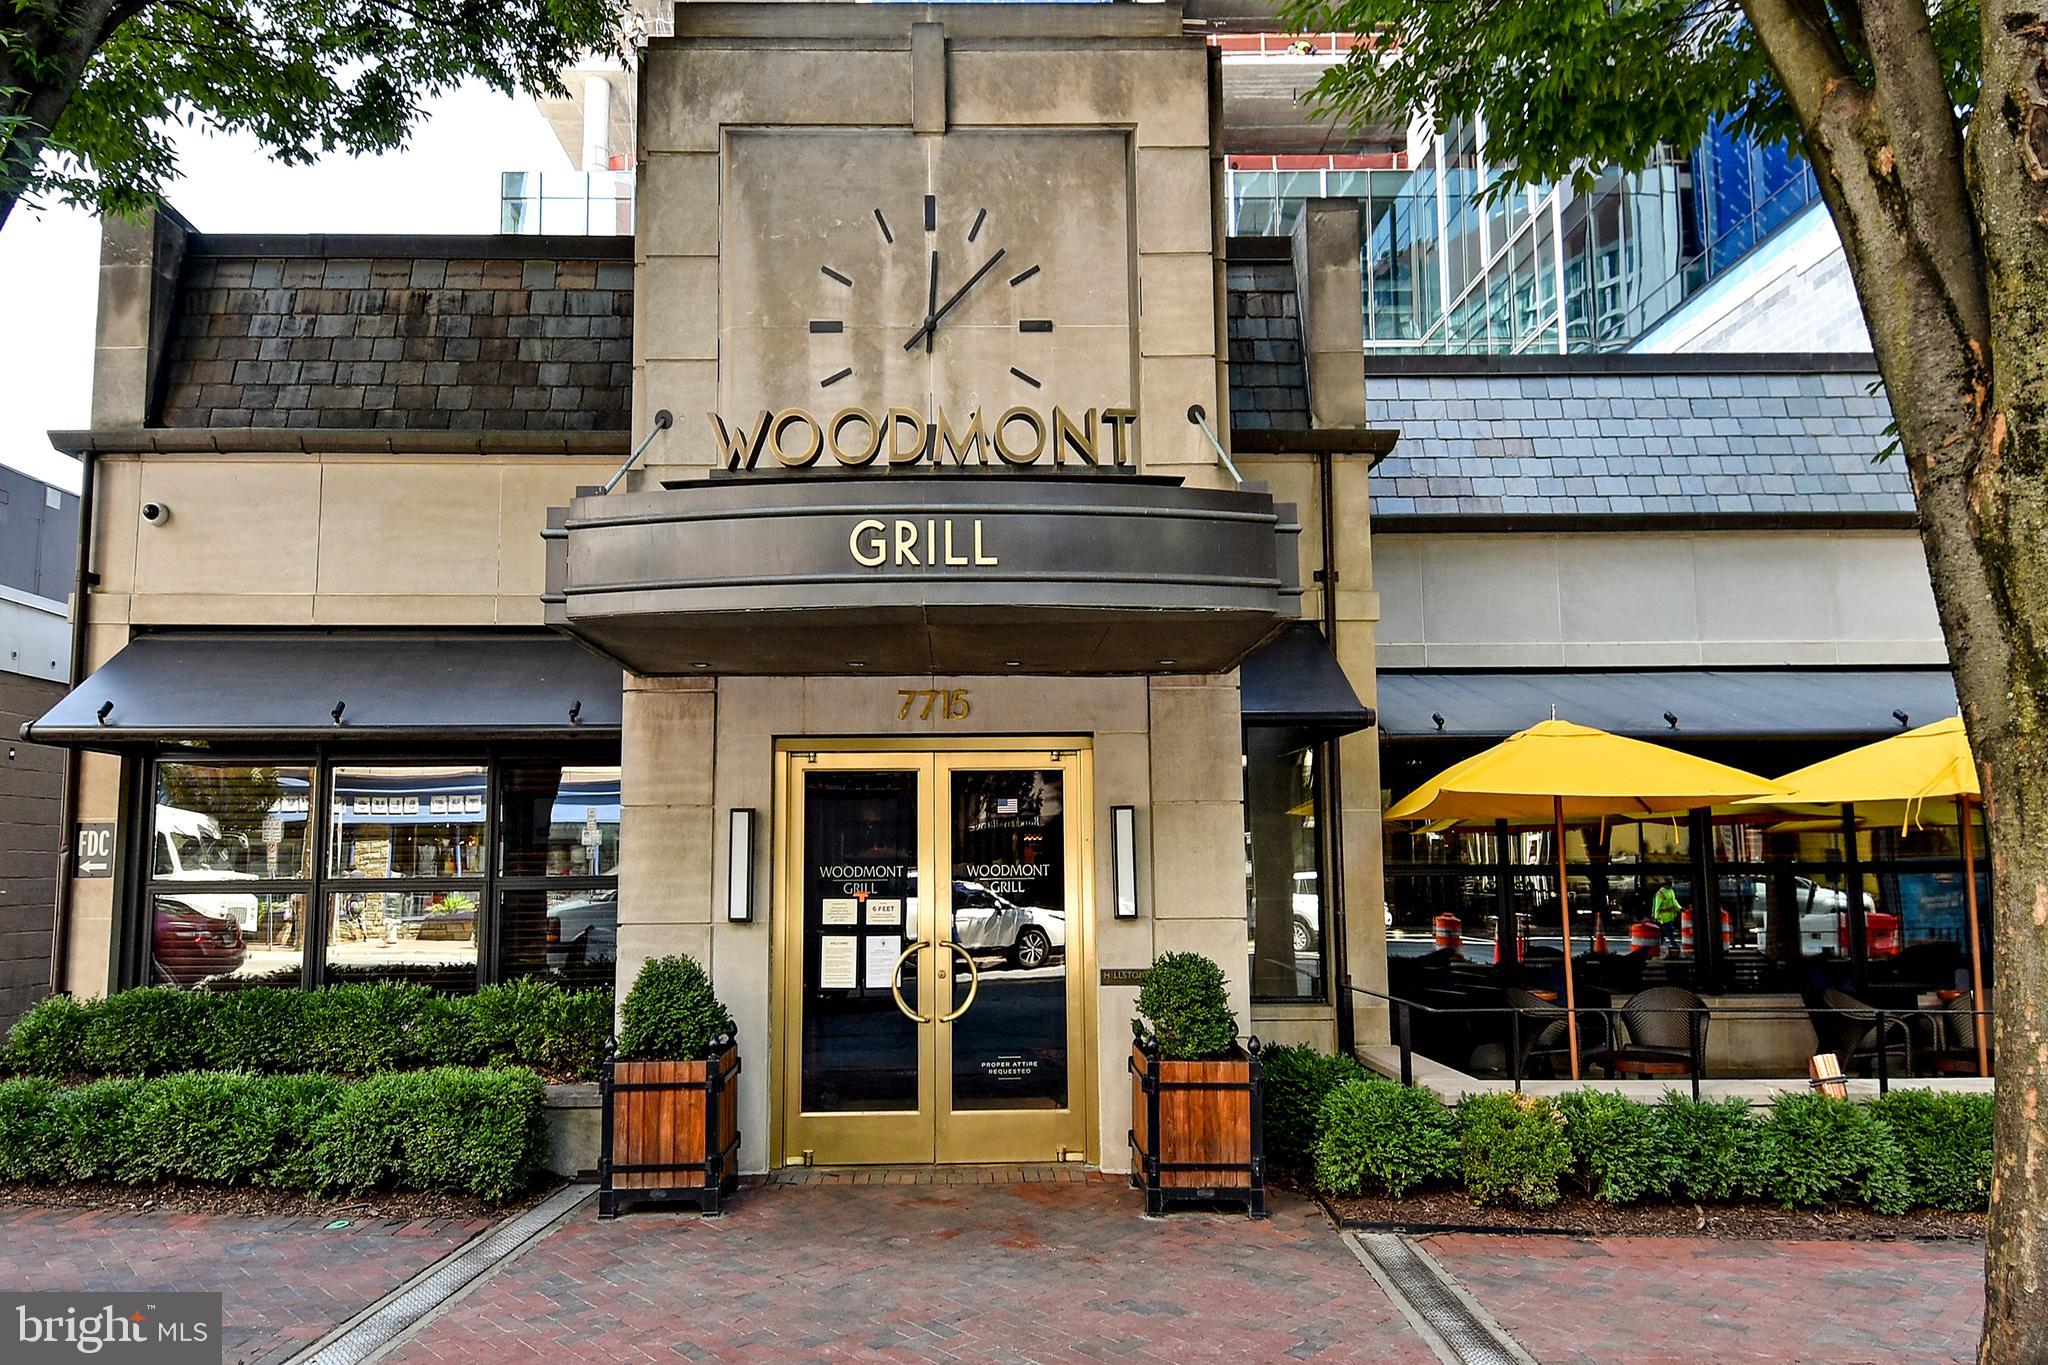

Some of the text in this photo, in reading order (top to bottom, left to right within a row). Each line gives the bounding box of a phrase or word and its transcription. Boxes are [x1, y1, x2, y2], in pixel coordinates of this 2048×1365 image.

[708, 405, 1137, 471] WOODMONT
[849, 519, 999, 567] GRILL
[898, 689, 971, 721] 7715
[78, 830, 110, 857] FDC
[819, 865, 904, 878] WOODMONT
[966, 864, 1050, 877] WOODMONT
[843, 882, 878, 894] GRILL
[990, 880, 1025, 893] GRILL
[1103, 971, 1142, 979] HILLSTO
